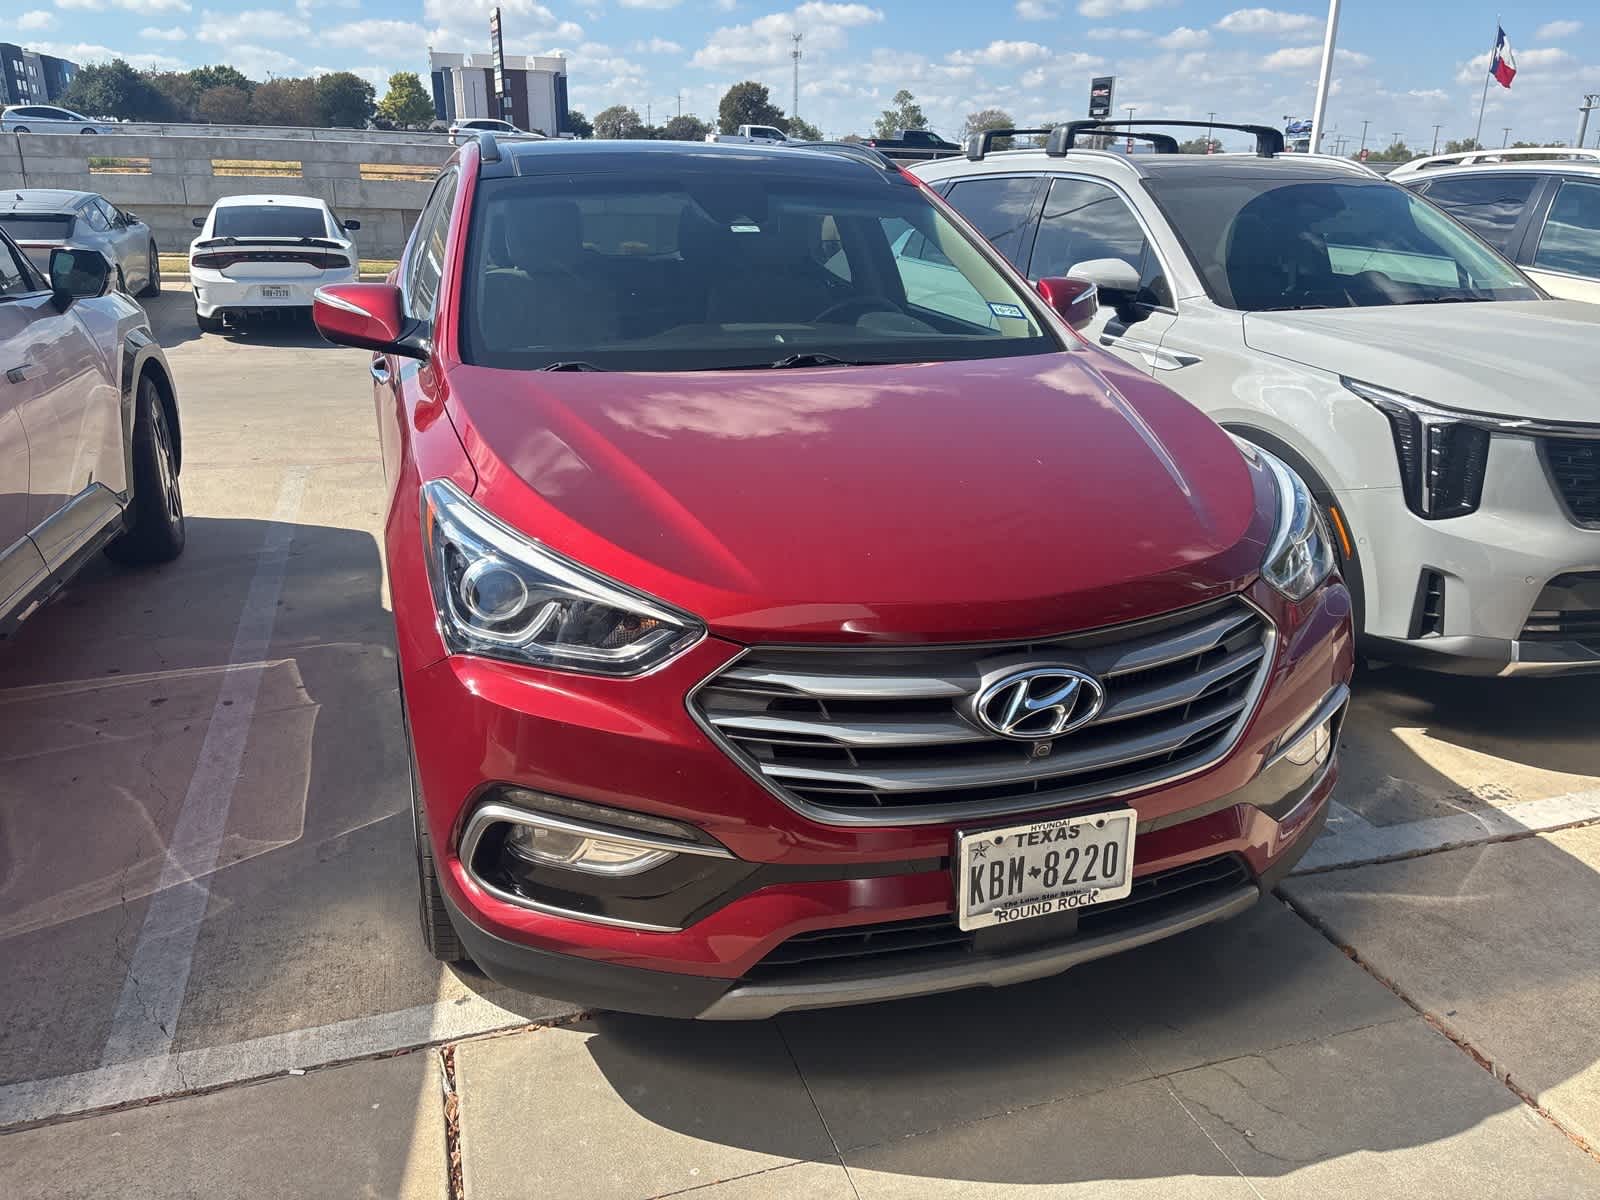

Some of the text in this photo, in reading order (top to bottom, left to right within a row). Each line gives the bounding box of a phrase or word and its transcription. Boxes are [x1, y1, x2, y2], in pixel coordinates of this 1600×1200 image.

[1014, 824, 1081, 848] TEXAS
[1030, 819, 1071, 832] HYUNDAI
[970, 841, 1119, 906] KBM 8220
[998, 892, 1097, 923] ROUND ROCK
[1003, 888, 1082, 909] The Lone Star State
